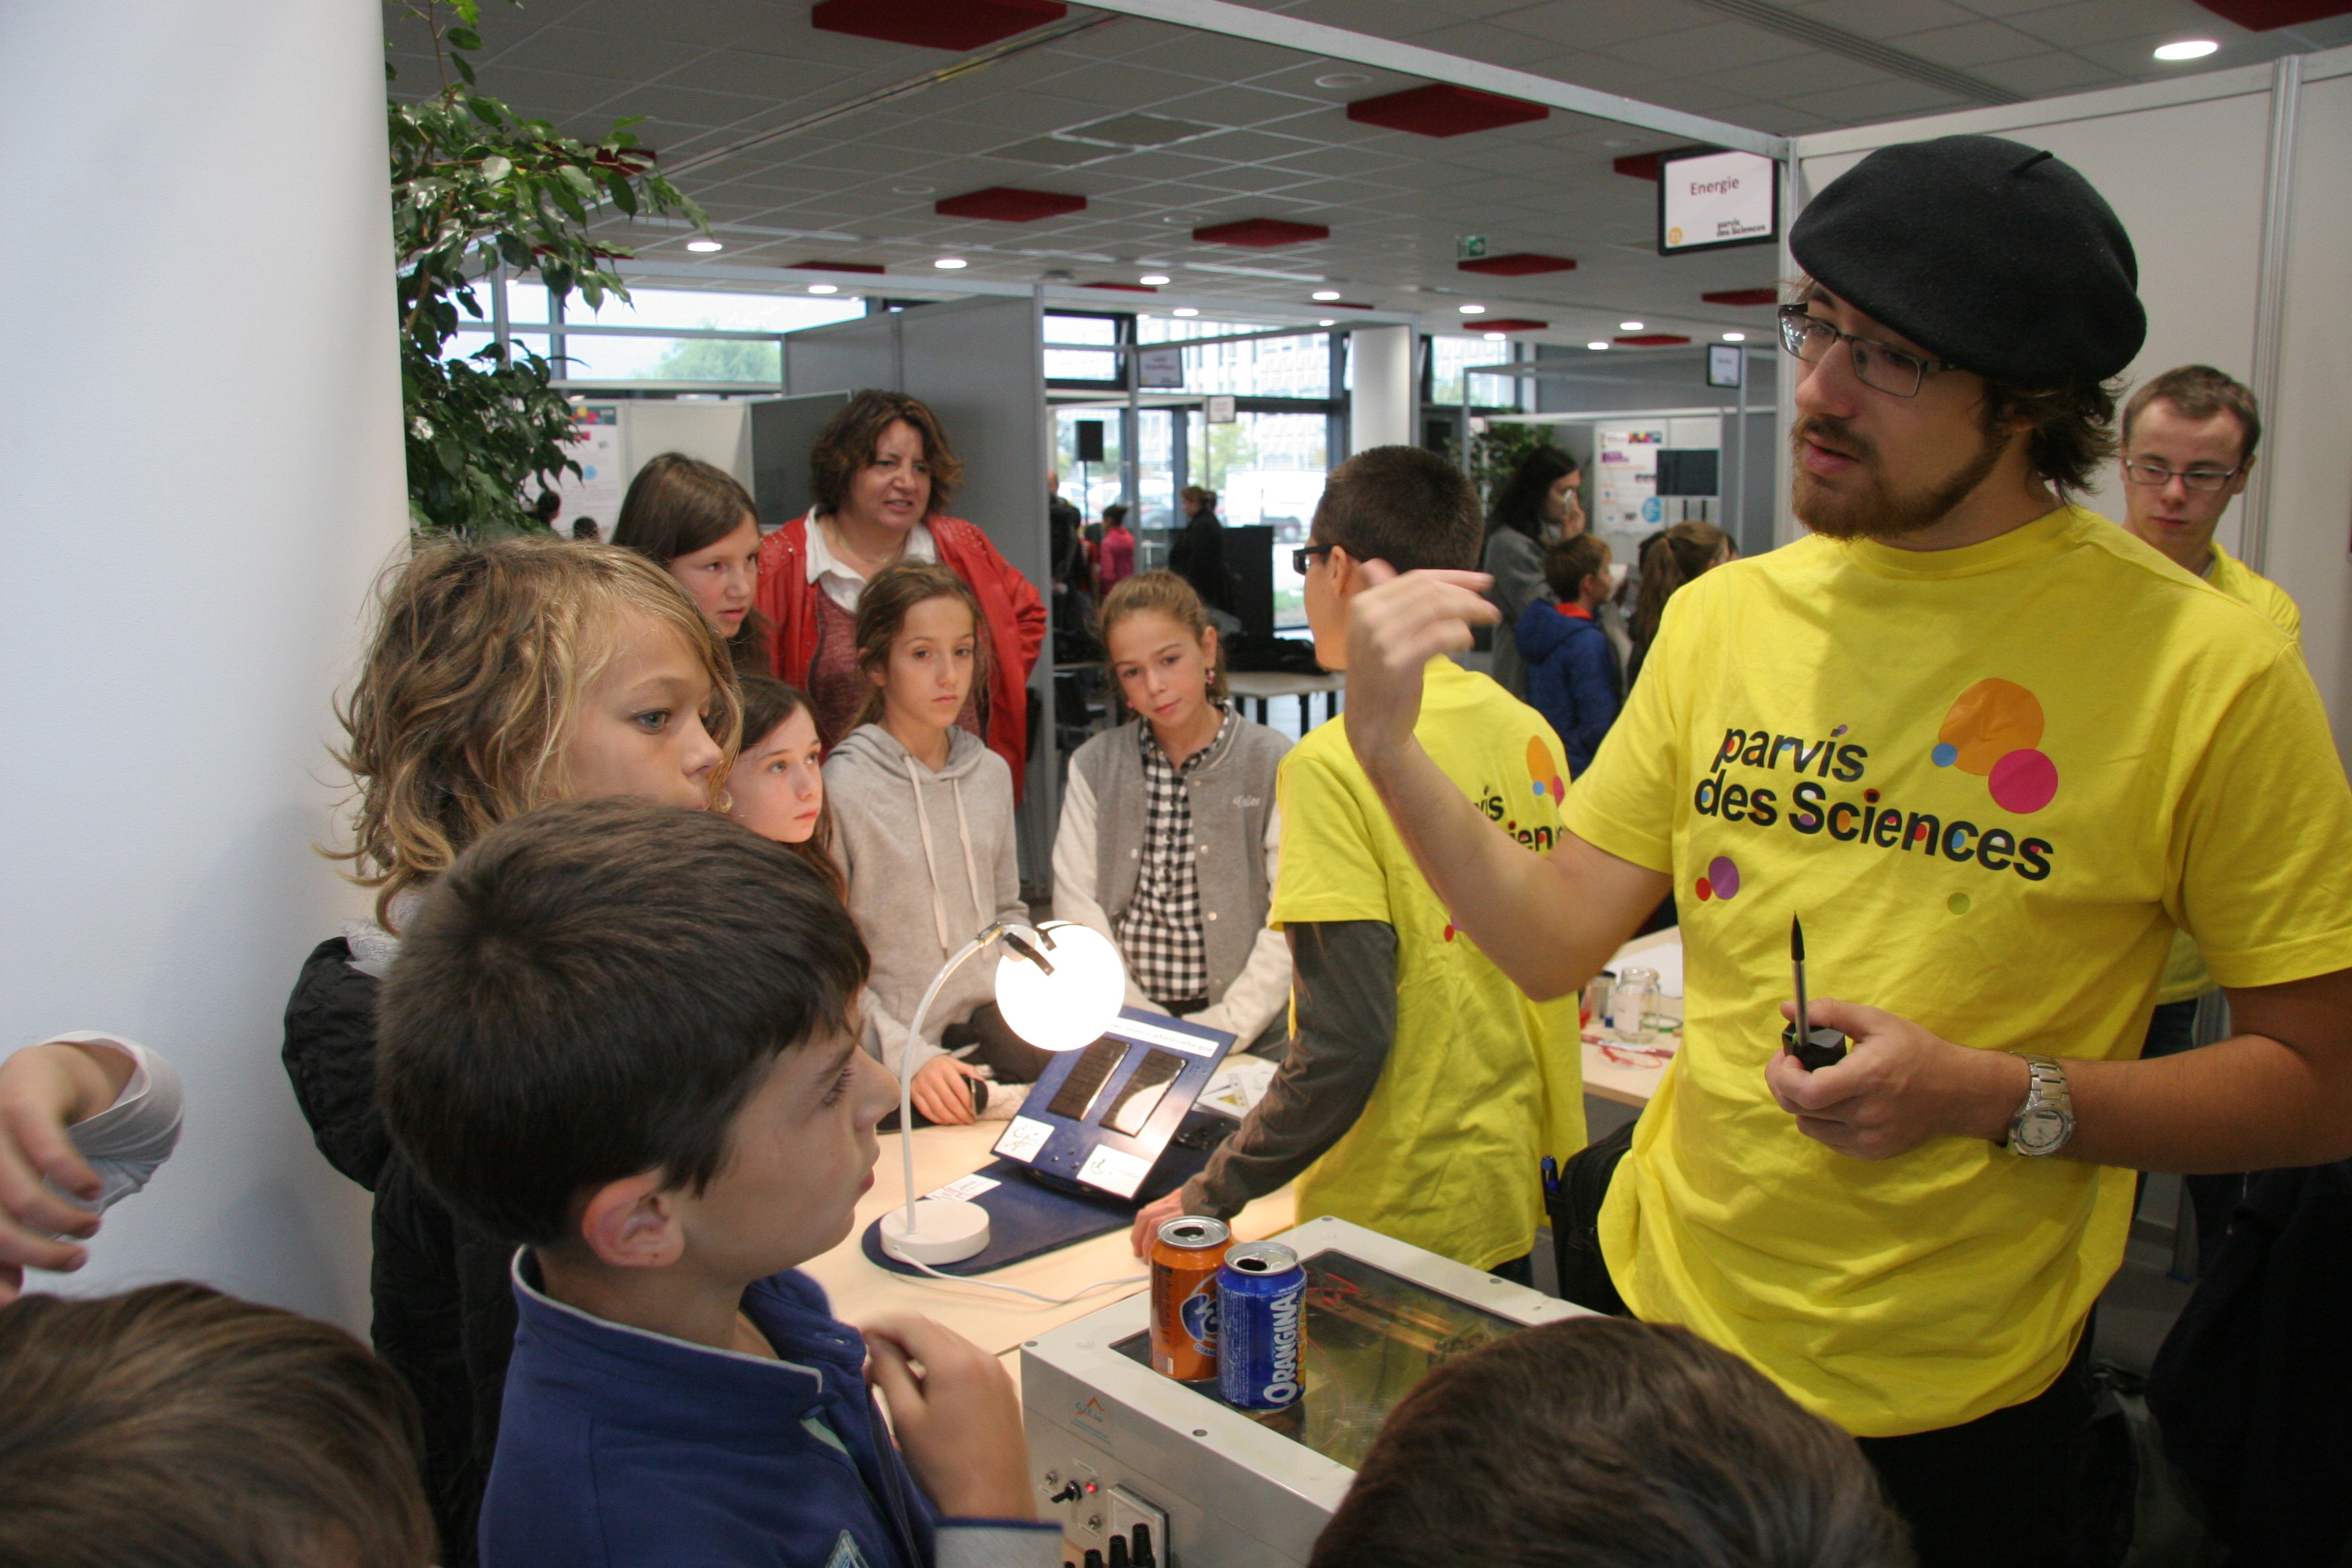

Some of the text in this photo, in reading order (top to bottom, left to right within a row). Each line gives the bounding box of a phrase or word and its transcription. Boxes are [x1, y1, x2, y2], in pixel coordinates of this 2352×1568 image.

[1690, 177, 1740, 195] Energie
[1710, 726, 1868, 783] parvis
[1694, 769, 2054, 881] des Sciences
[1263, 1291, 1298, 1404] ORANGINA
